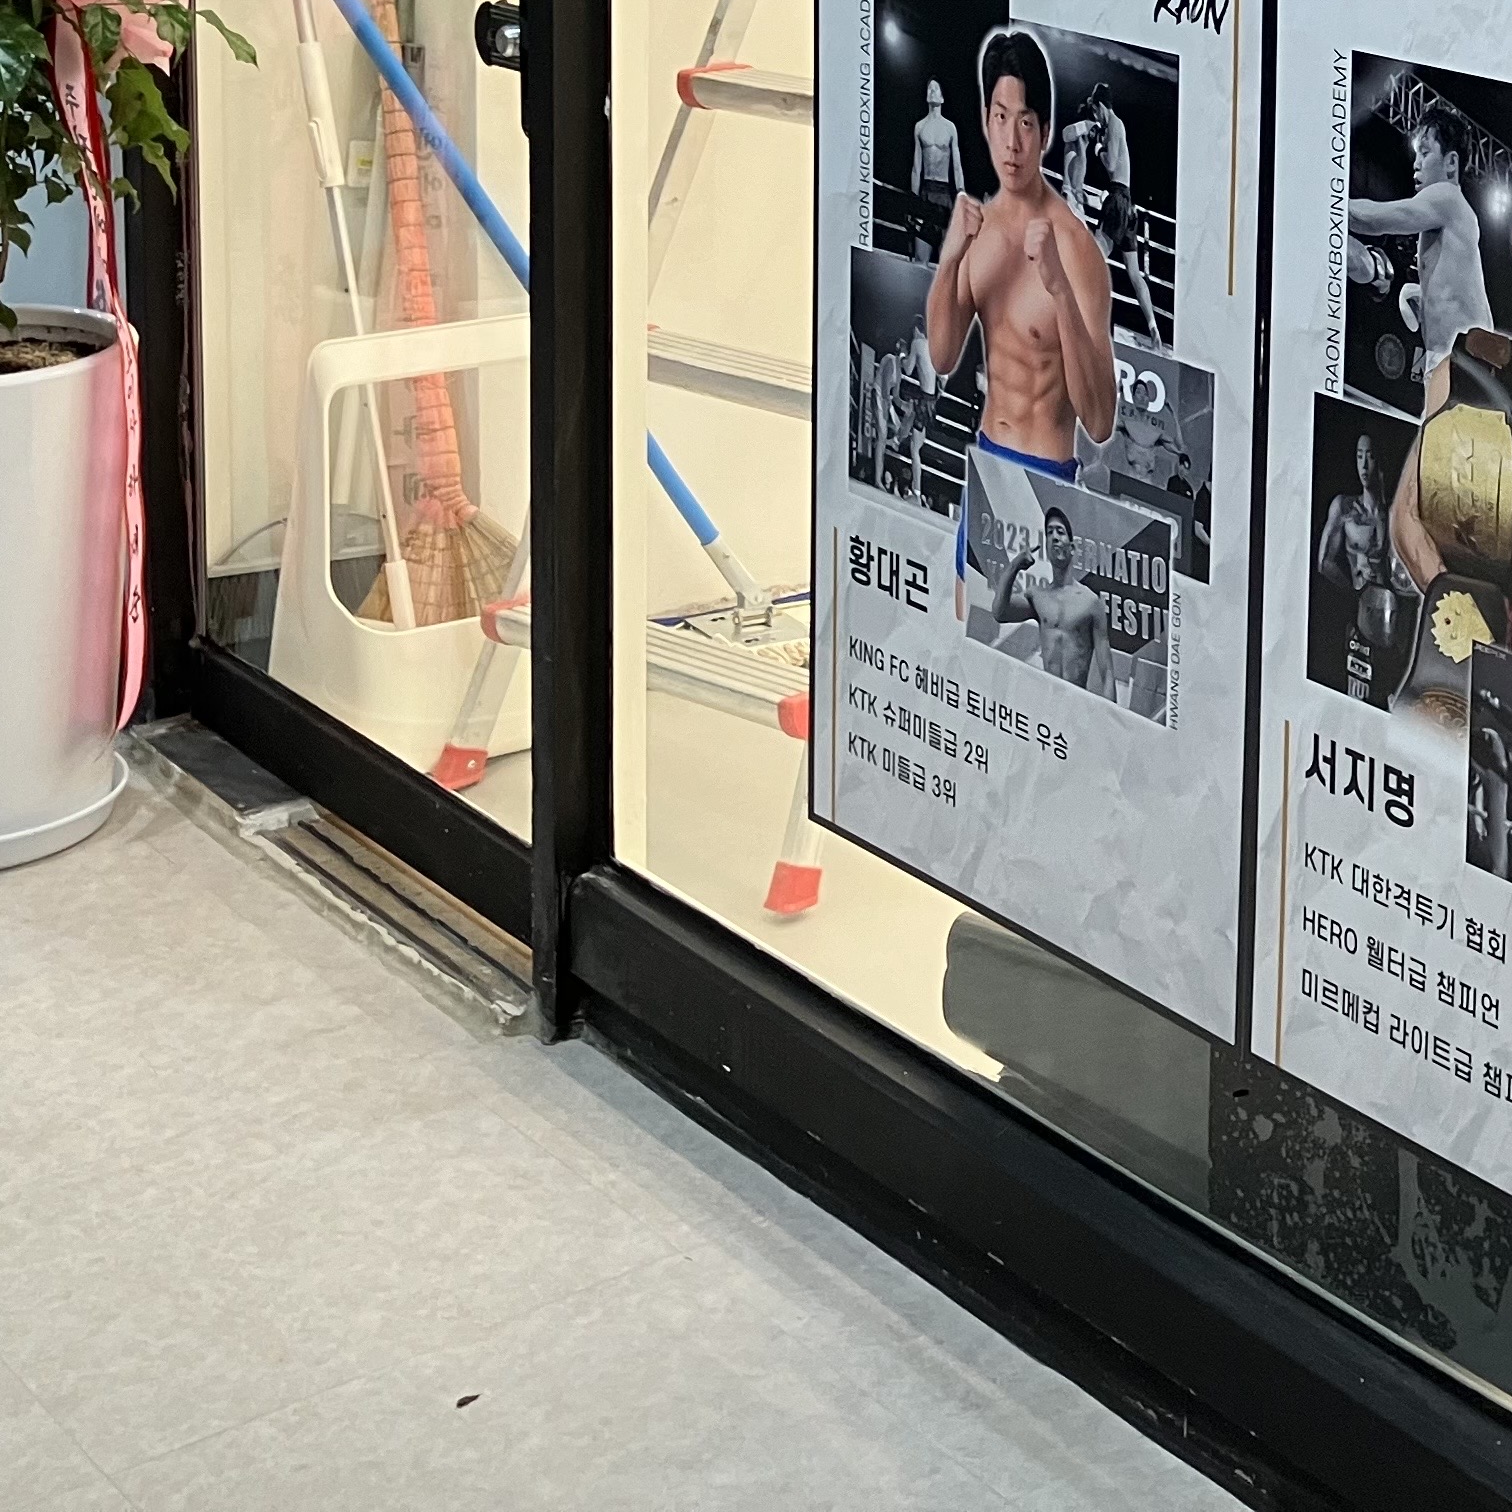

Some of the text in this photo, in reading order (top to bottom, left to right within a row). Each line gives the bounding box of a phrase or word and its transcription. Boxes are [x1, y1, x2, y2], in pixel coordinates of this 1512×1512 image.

[859, 63, 871, 185] KICKBOXING
[858, 189, 871, 247] RAON
[1325, 49, 1347, 393] RAON KICKBOXING ACADEMY
[849, 535, 929, 613] 황대곤
[850, 636, 1067, 759] KING FC 헤비급 토너먼트 우승
[1169, 593, 1182, 731] HWANG DAE GON
[849, 684, 988, 773] KTK 슈퍼미들급 2위
[849, 732, 955, 807] KTK 미들급 3위
[1306, 733, 1414, 827] 서지명
[1305, 843, 1343, 884] KTK
[1352, 864, 1454, 940] 대한격투기
[1465, 918, 1506, 964] 협회
[1302, 968, 1383, 1034] 미르메컵
[1390, 1014, 1472, 1083] 라이트급
[1303, 906, 1357, 954] HERO
[1437, 971, 1499, 1029] 챔피언
